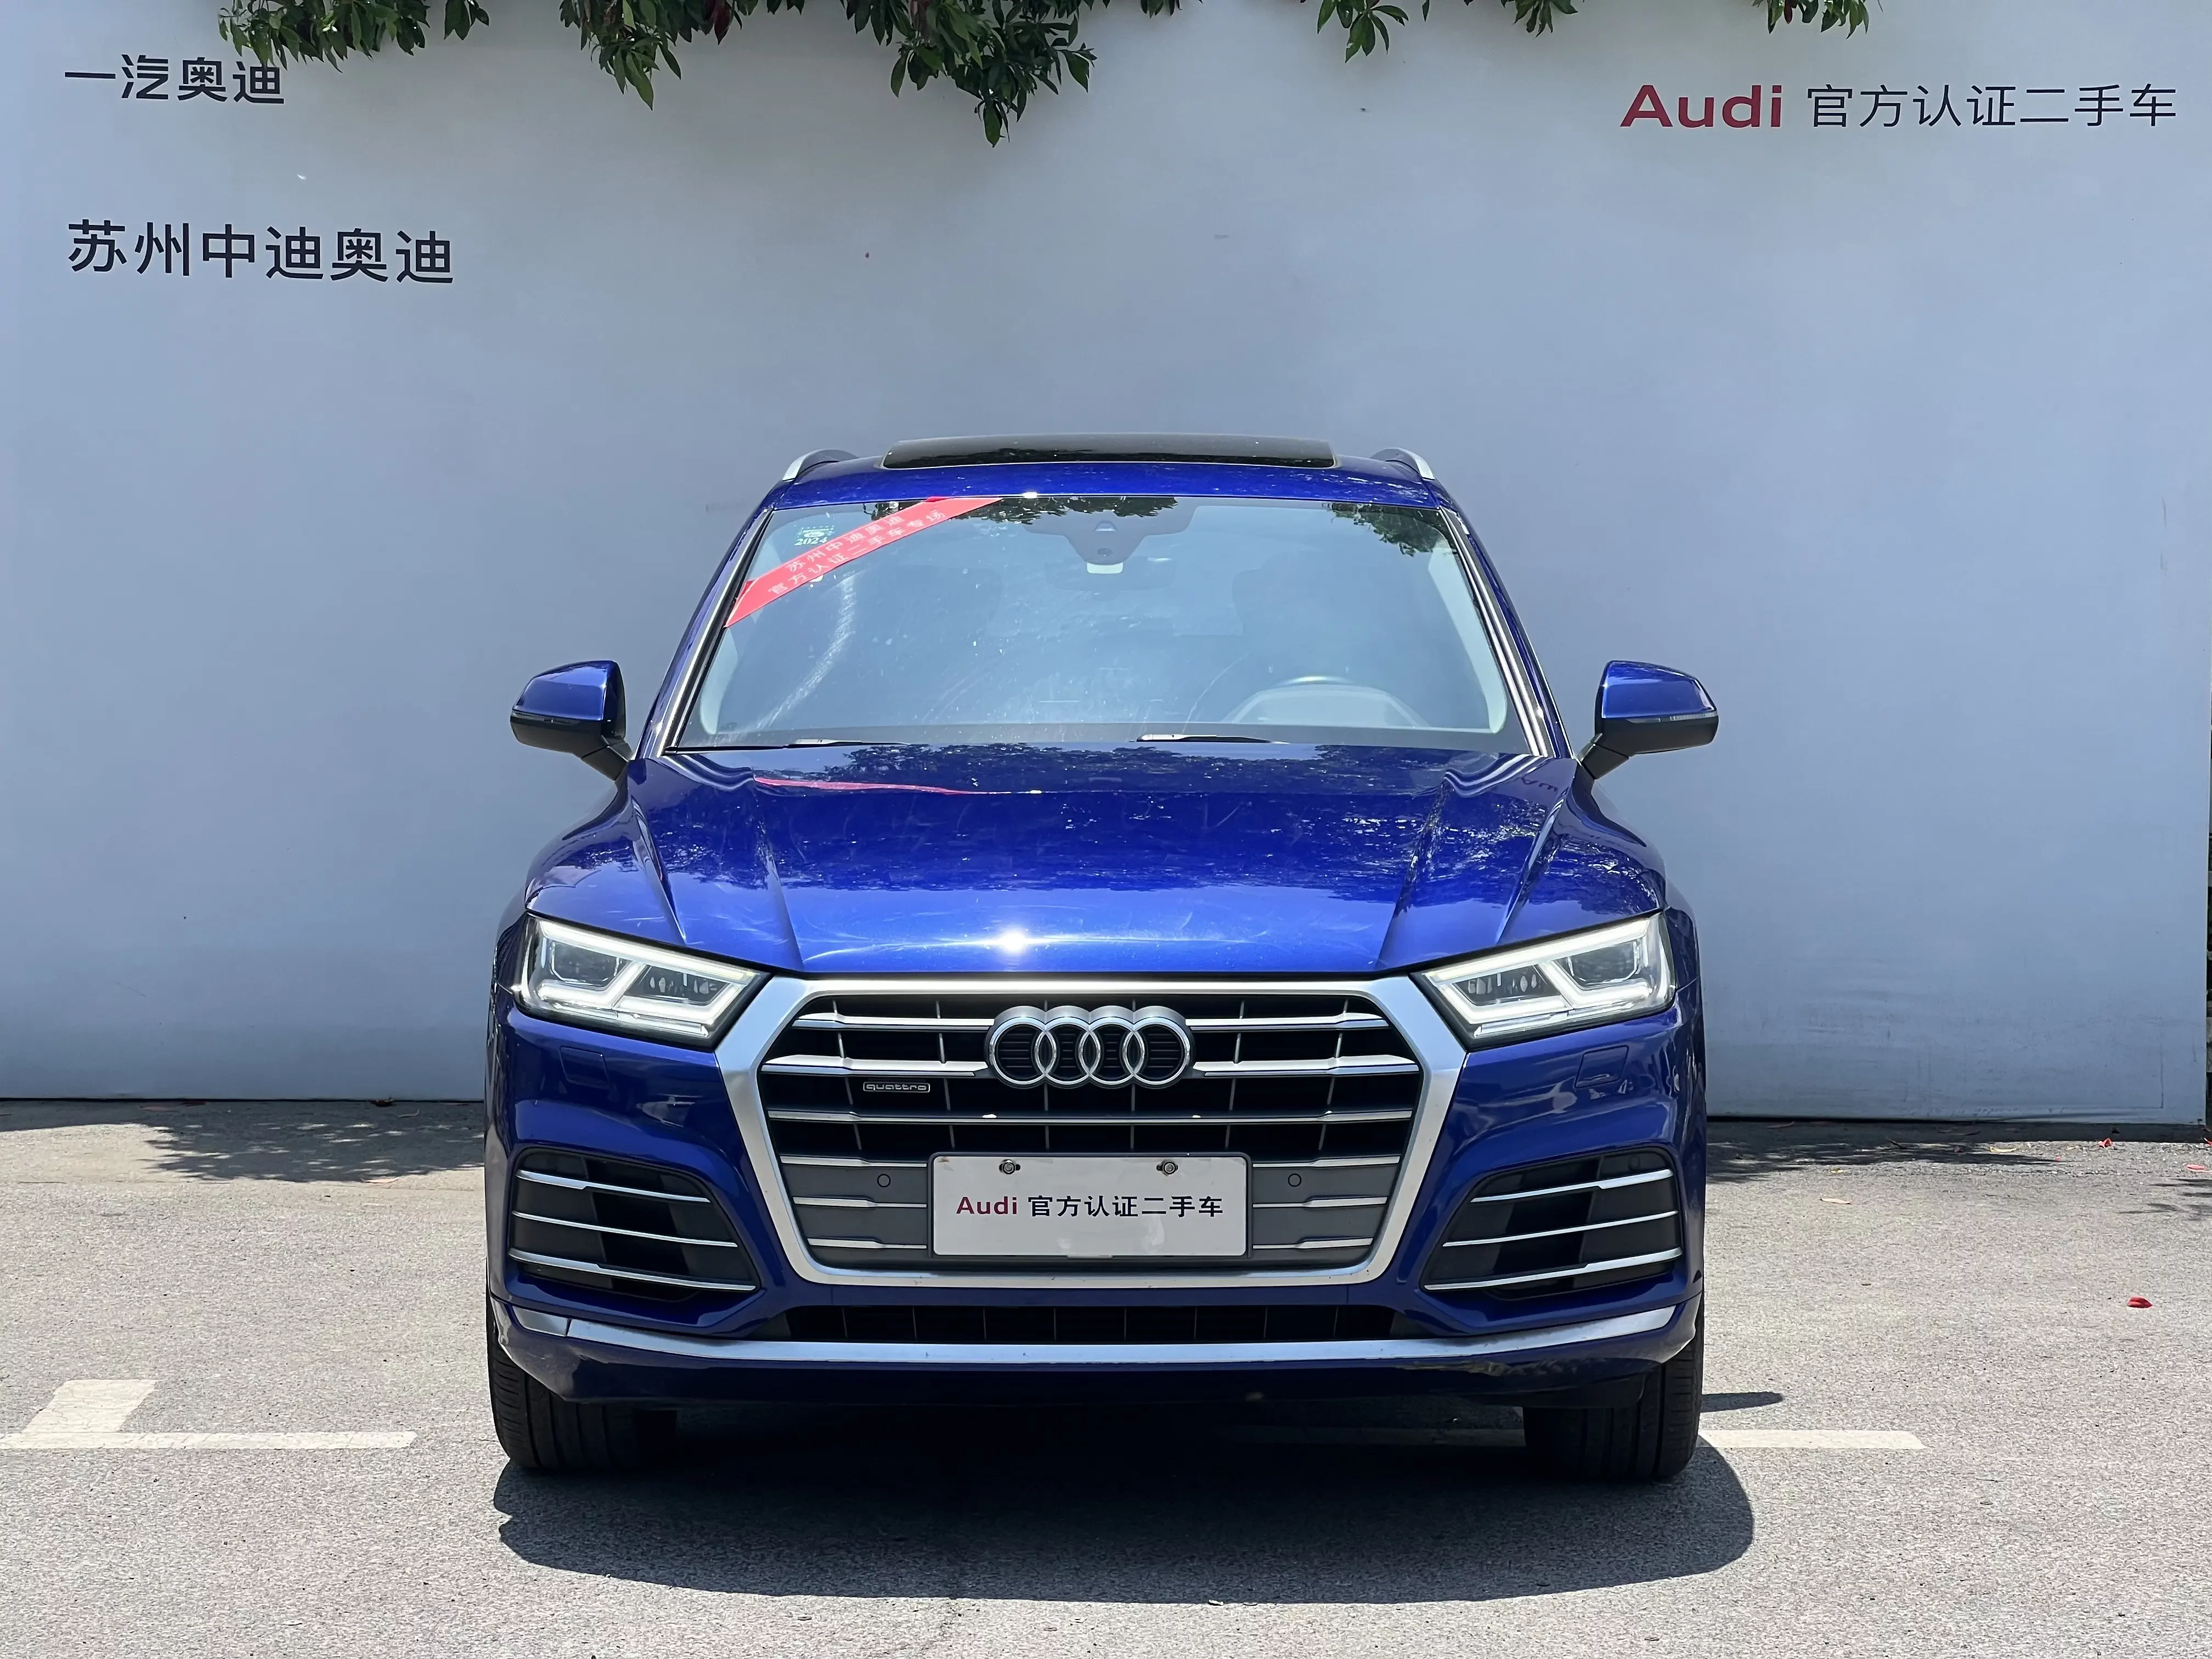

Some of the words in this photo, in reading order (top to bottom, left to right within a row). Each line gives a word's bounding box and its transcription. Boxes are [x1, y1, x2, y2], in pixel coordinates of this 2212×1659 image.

[64, 54, 285, 104] 一汽奥迪
[1620, 84, 1782, 128] Audi
[1807, 83, 2176, 127] 官方认证二手车
[68, 219, 454, 284] 苏州中迪奥迪
[768, 510, 946, 594] 官方认证二手车专场
[786, 516, 905, 572] 苏州中迪奥迪
[794, 536, 827, 546] 2024
[956, 1195, 1018, 1215] Audi
[1028, 1195, 1223, 1217] 官方认证二手车
